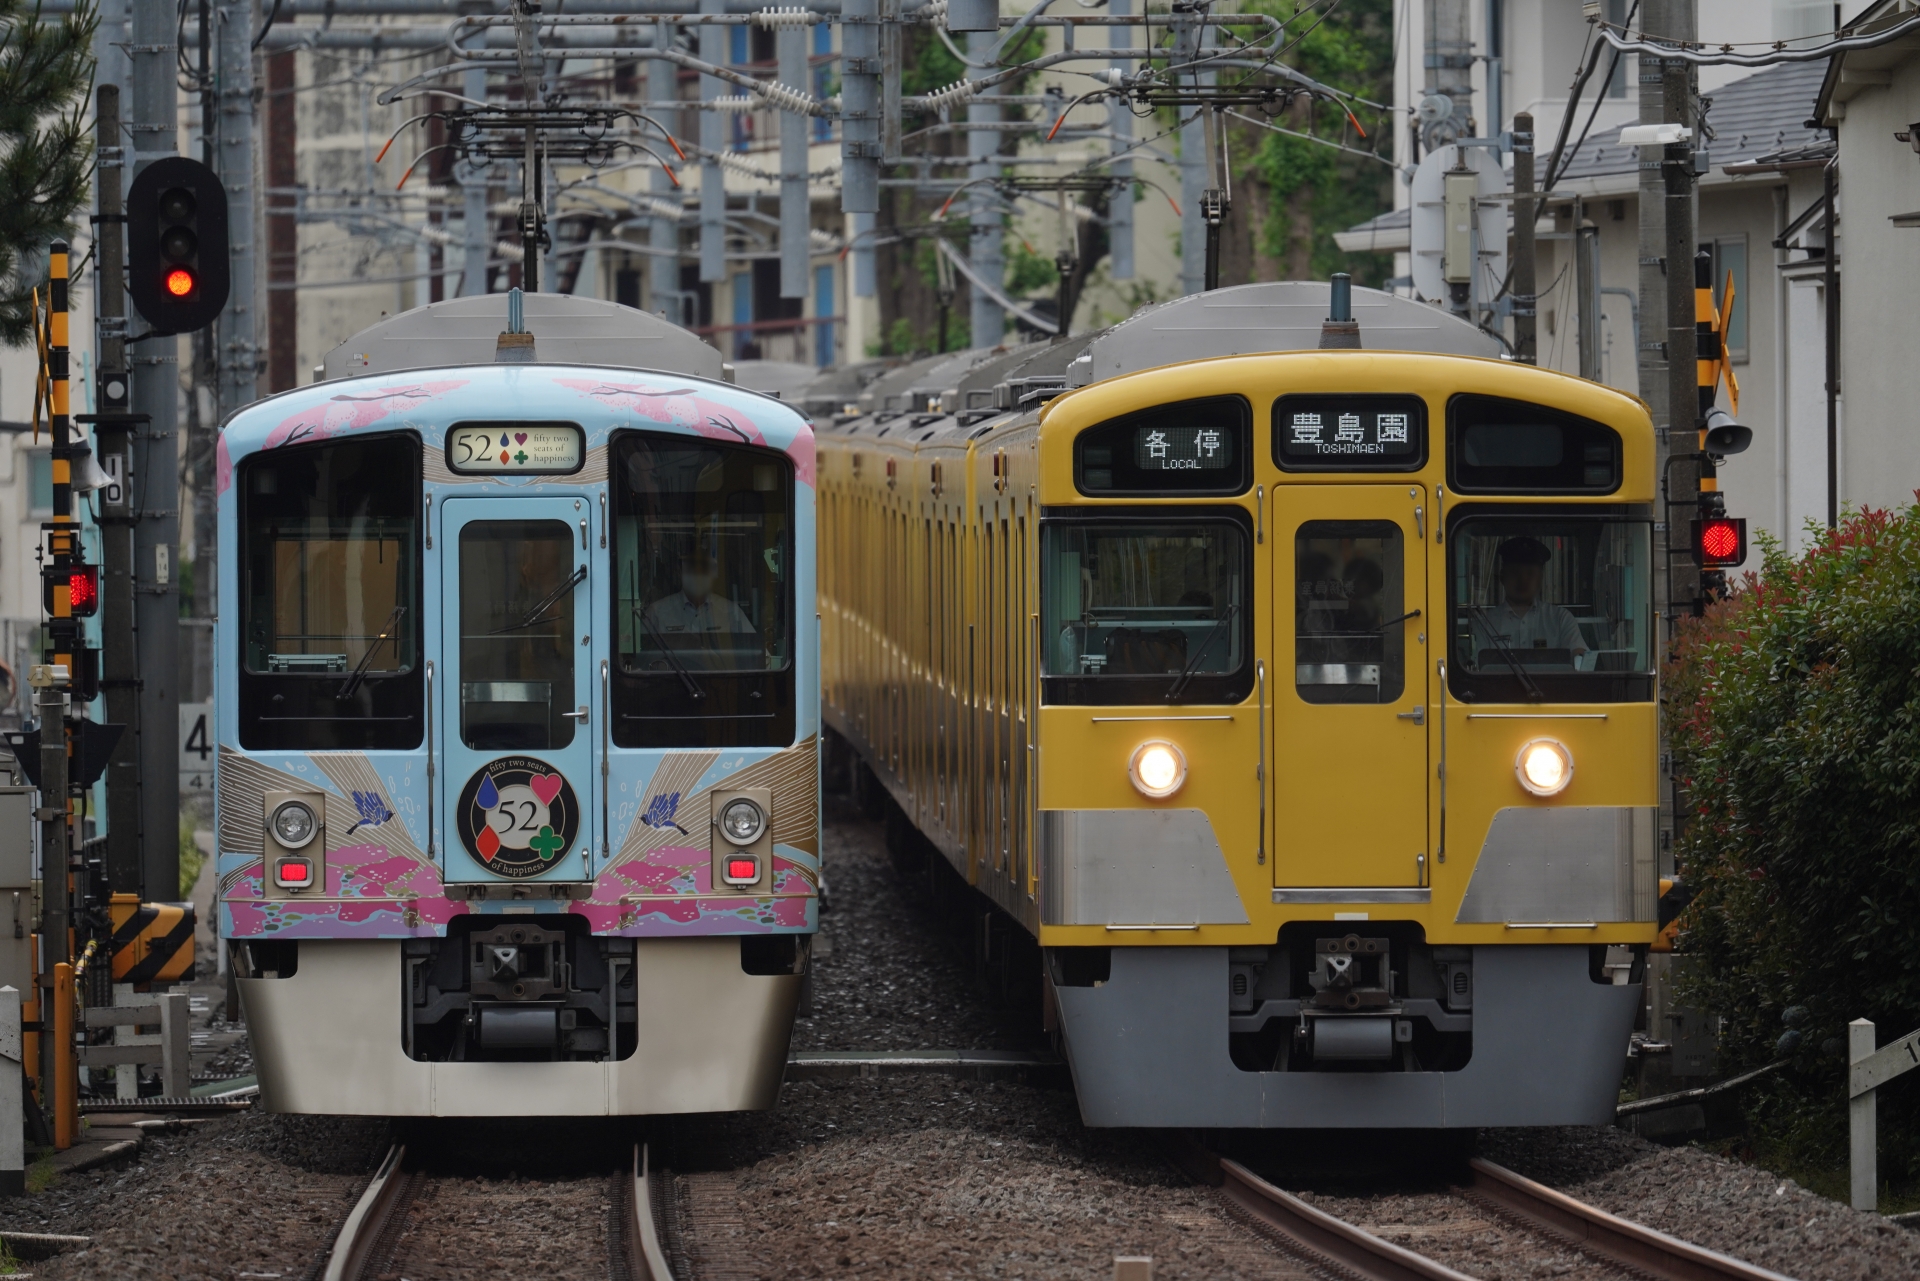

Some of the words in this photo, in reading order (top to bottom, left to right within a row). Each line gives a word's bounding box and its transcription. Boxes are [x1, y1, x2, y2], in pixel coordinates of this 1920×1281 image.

[1290, 412, 1408, 444] 豊島園
[533, 433, 551, 444] fifty
[553, 434, 569, 442] two
[1144, 429, 1220, 458] 各停
[457, 433, 493, 465] 52
[555, 443, 565, 452] of
[1315, 443, 1384, 454] TOSHIMAEN
[533, 453, 575, 465] happiness
[1162, 459, 1202, 470] LOCAL
[489, 760, 507, 773] fifty
[526, 761, 547, 773] seats
[498, 800, 539, 834] 52
[491, 862, 502, 871] of
[502, 862, 545, 877] happiness
